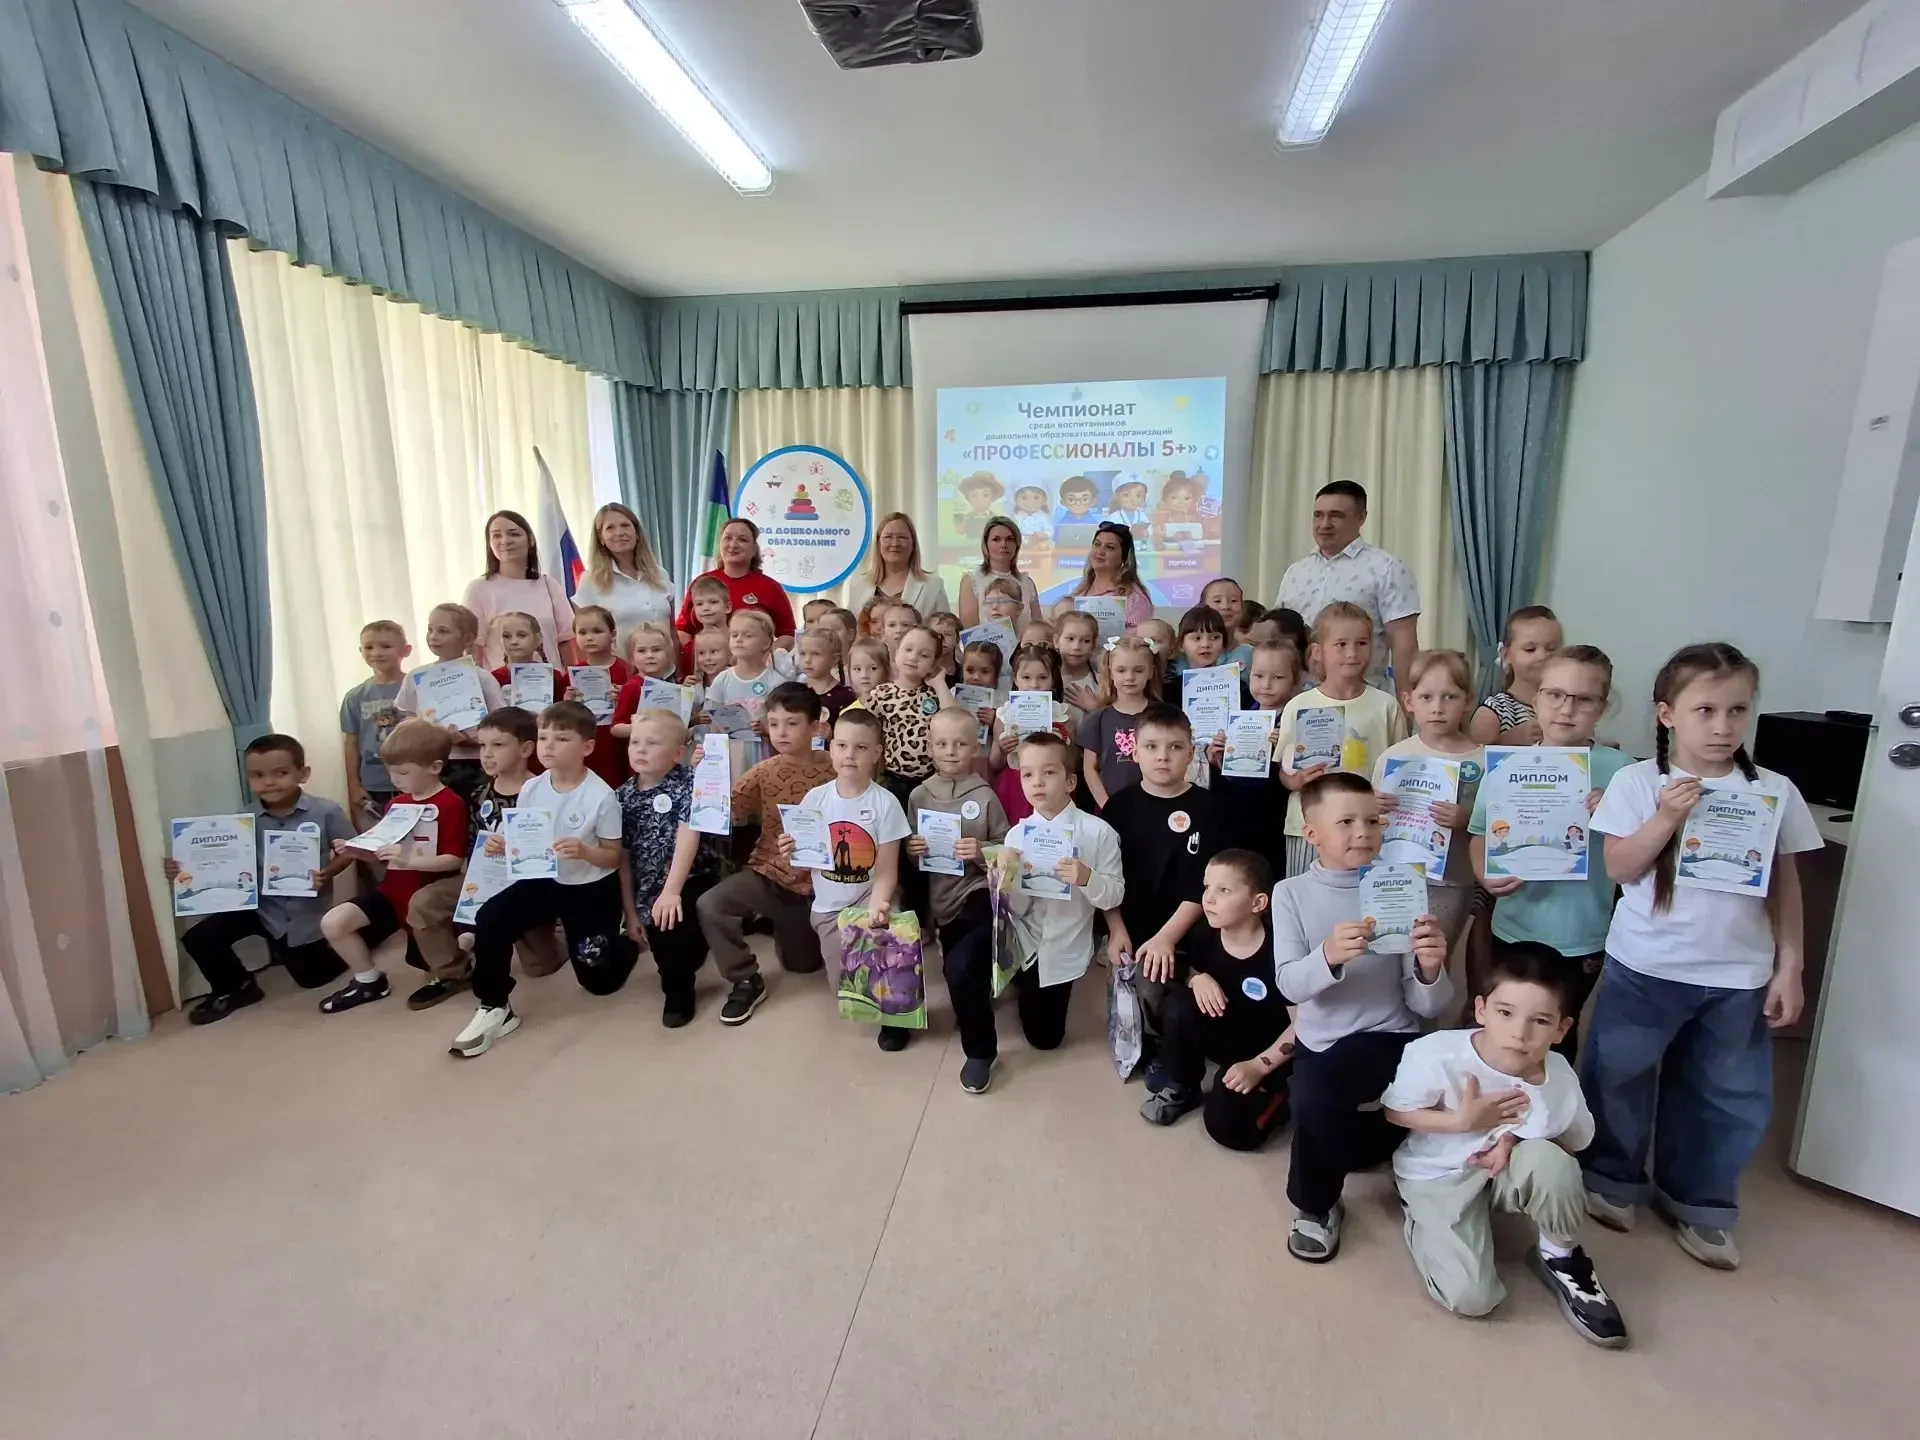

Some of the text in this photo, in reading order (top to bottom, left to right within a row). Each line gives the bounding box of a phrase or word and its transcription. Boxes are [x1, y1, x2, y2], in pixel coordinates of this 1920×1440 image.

[1018, 402, 1136, 419] Чемпионат
[1058, 420, 1126, 428] воспитанников
[1040, 430, 1115, 439] образовательных
[1117, 428, 1173, 437] организаций
[963, 440, 1197, 461] «ПРОФЕССИОНАЛЫ 5+»
[775, 527, 851, 536] ДОШКОЛЬНОГО
[768, 538, 836, 547] ОБРАЗОВАНИЯ
[429, 671, 464, 687] ДИПЛОМ
[1196, 683, 1230, 693] ДИПЛОМ
[1306, 717, 1335, 725] ДИПЛОМ
[1509, 773, 1569, 783] ДИПЛОМ
[1398, 779, 1441, 791] ДИПЛОМ
[1706, 804, 1756, 817] ДИПЛОМ
[191, 834, 238, 845] ДИПЛОМ
[843, 874, 869, 882] HEAD
[1373, 879, 1412, 888] ДИПЛОМ
